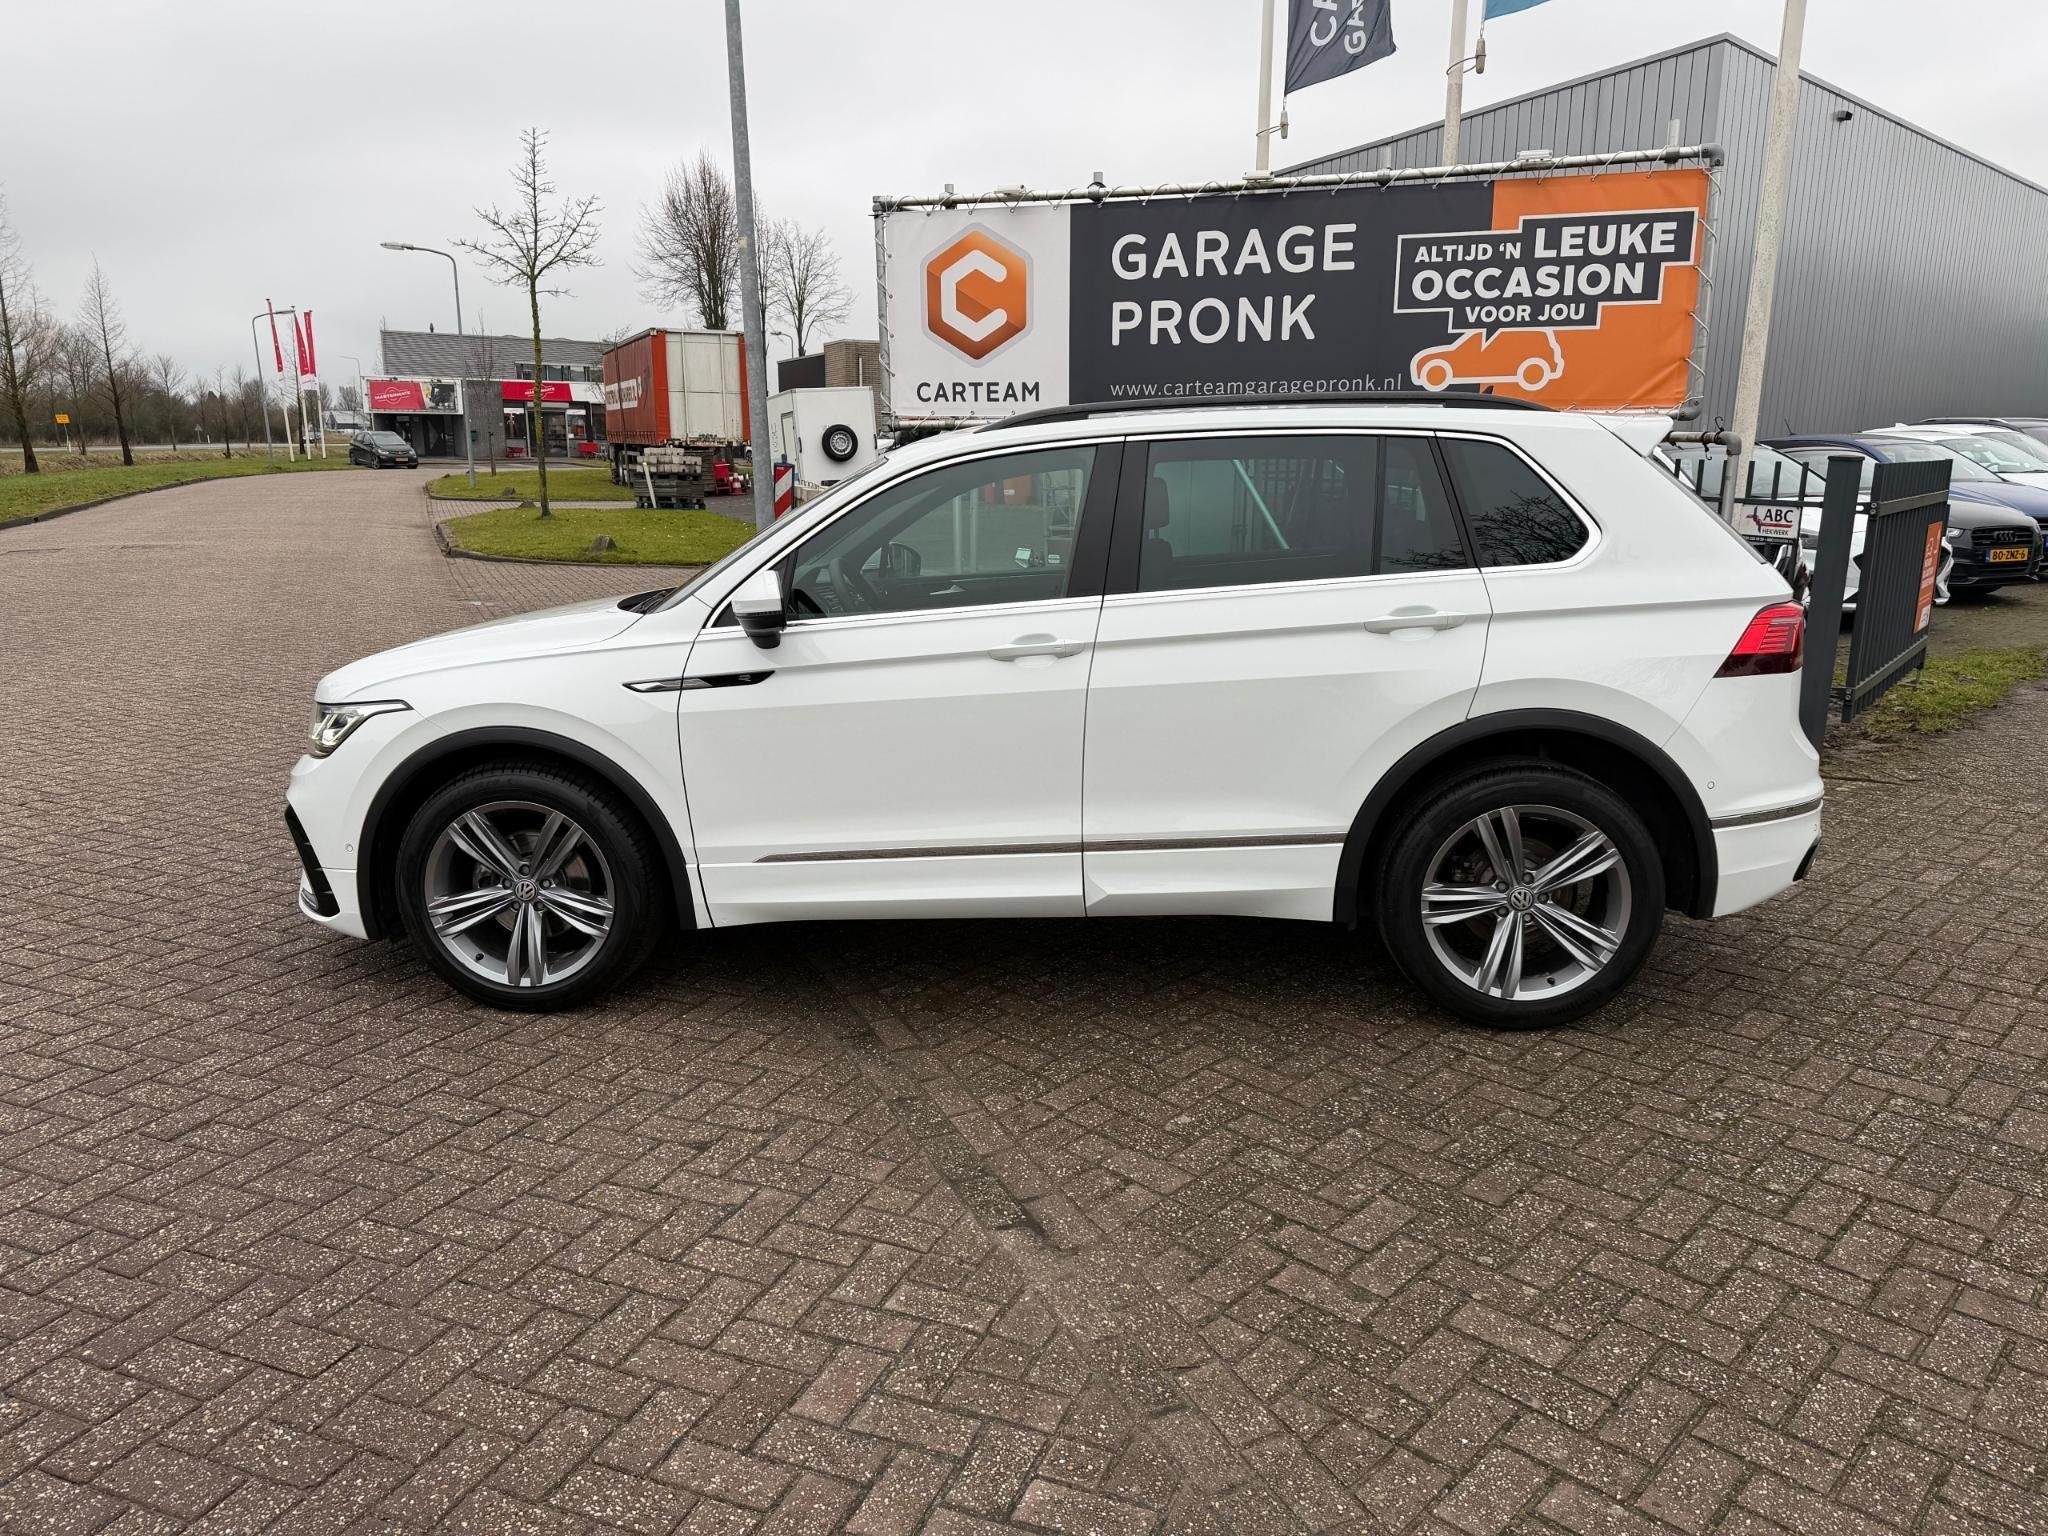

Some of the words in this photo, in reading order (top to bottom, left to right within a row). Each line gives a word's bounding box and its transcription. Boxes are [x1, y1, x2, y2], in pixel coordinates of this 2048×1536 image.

[1111, 223, 1357, 280] GARAGE
[1415, 243, 1493, 263] ALTIJD
[1534, 221, 1678, 257] LEUKE
[1411, 262, 1645, 301] OCCASION
[1111, 294, 1316, 346] PRONK
[1465, 305, 1531, 323] VOOR
[1538, 303, 1585, 321] JOU
[916, 381, 1040, 402] CARTEAM
[1110, 373, 1402, 396] www.carteamgaragepronk.nl
[1763, 509, 1794, 523] ABC
[1761, 528, 1789, 536] HEKWERK
